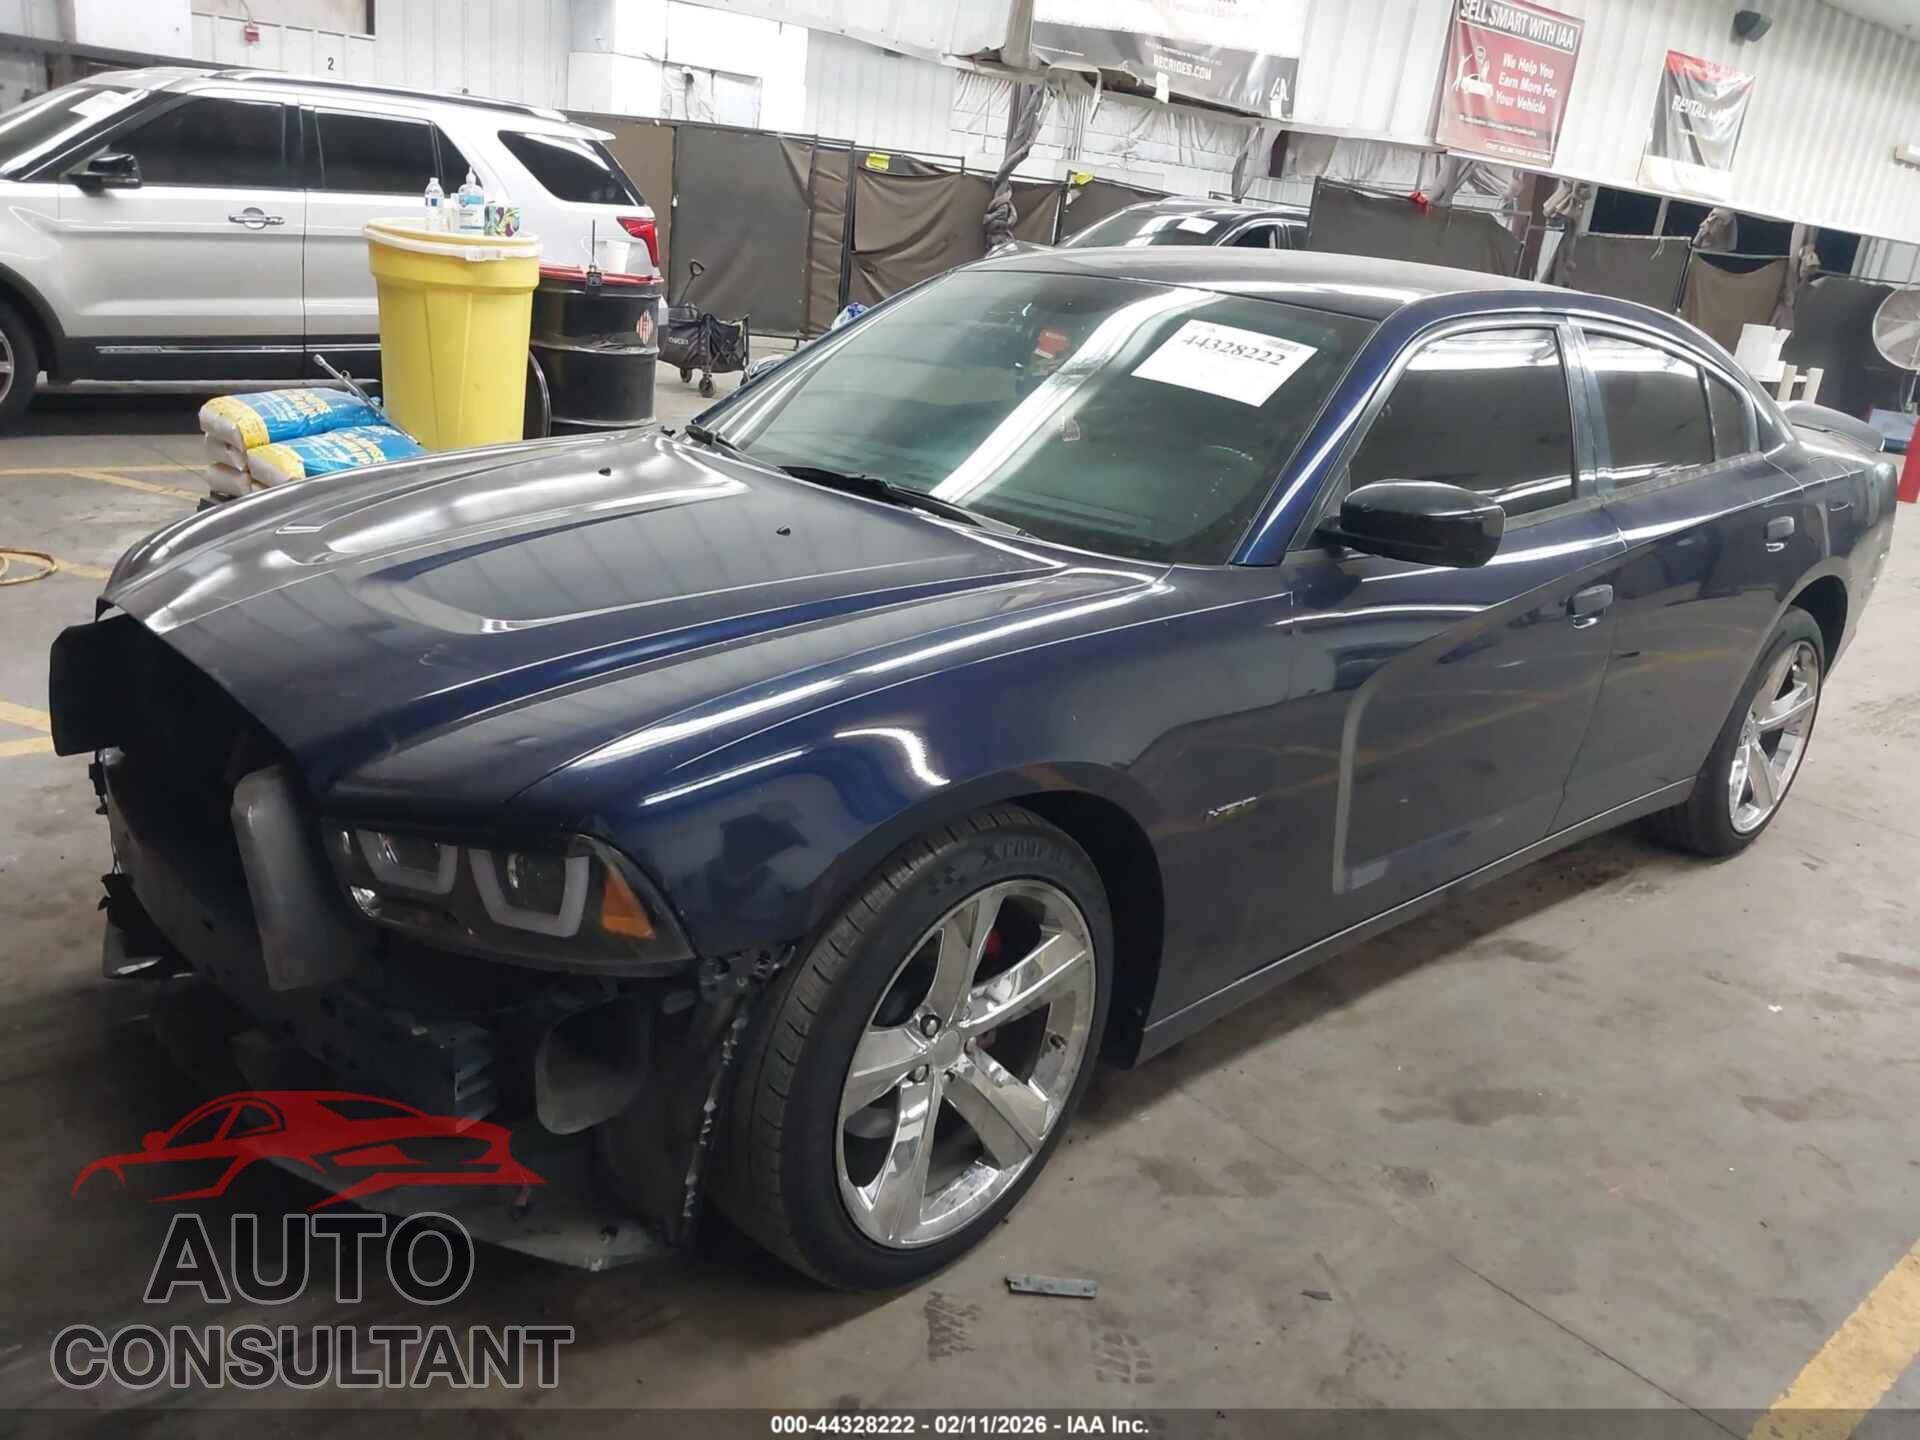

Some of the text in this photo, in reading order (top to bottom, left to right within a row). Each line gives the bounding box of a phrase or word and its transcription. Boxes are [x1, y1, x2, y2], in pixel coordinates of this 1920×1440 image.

[1460, 0, 1575, 49] SELL SMART WITH IAA
[327, 56, 335, 71] 2
[1503, 52, 1555, 80] We Help You
[1499, 71, 1558, 99] Earn More For
[1496, 89, 1547, 114] Your Vehicle
[1183, 335, 1286, 366] 44328222
